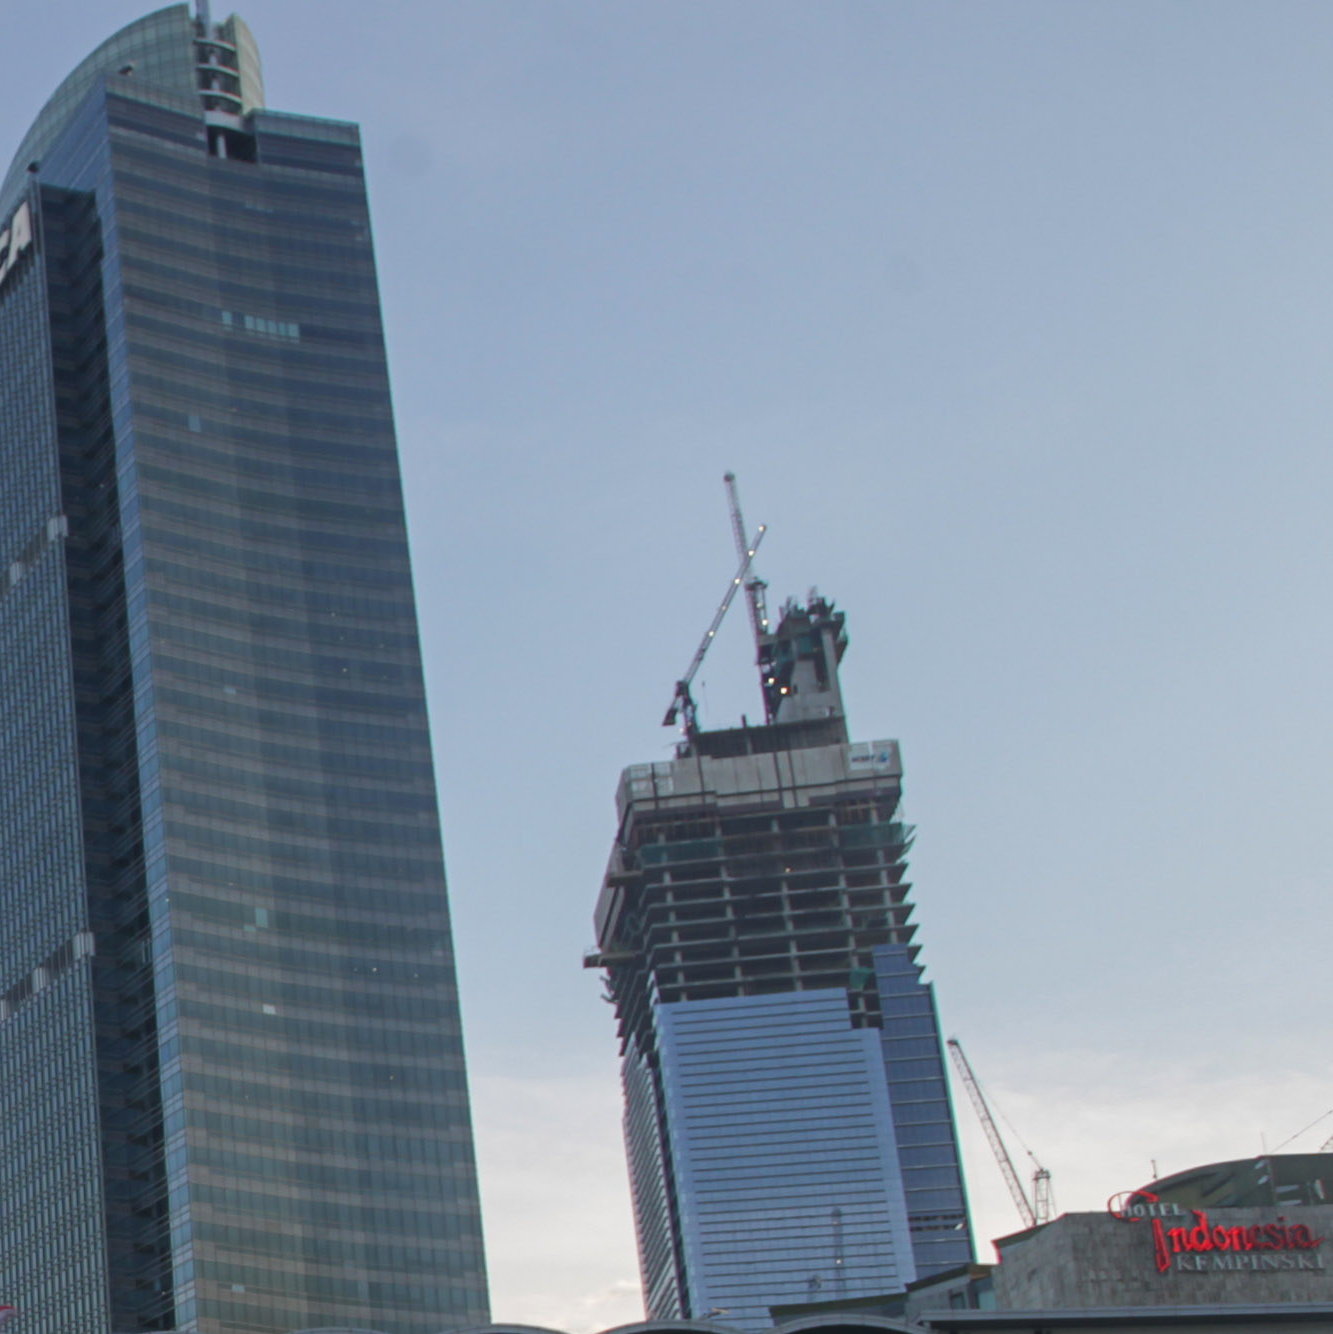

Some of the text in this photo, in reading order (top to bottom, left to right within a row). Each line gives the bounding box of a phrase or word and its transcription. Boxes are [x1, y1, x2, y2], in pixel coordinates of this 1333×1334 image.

[1121, 1203, 1184, 1218] HOTEL
[1151, 1209, 1325, 1273] Indonesia
[1177, 1254, 1326, 1272] KEMPINSKI
